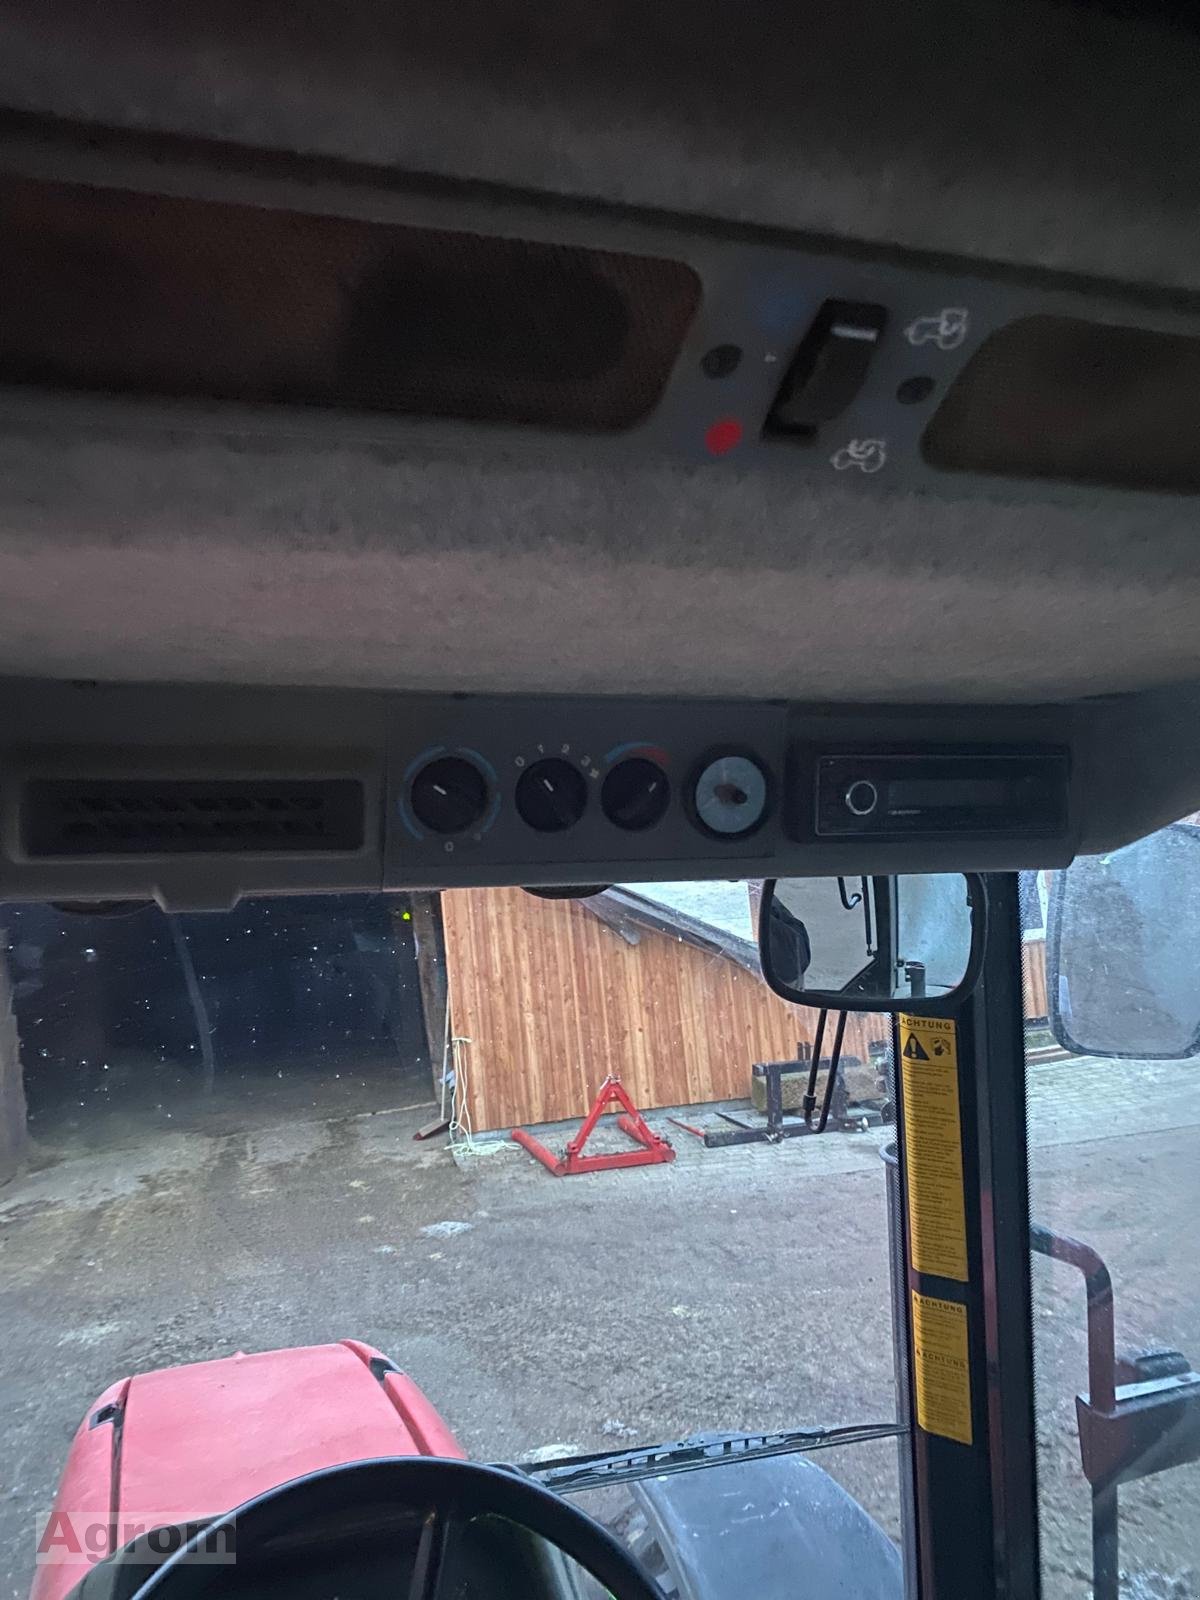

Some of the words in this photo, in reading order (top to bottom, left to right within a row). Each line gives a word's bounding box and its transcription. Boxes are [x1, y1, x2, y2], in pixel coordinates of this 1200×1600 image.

[901, 1017, 952, 1031] ACHTUNG
[919, 1298, 963, 1313] ACHTUNG
[922, 1352, 966, 1368] ACHTUNG
